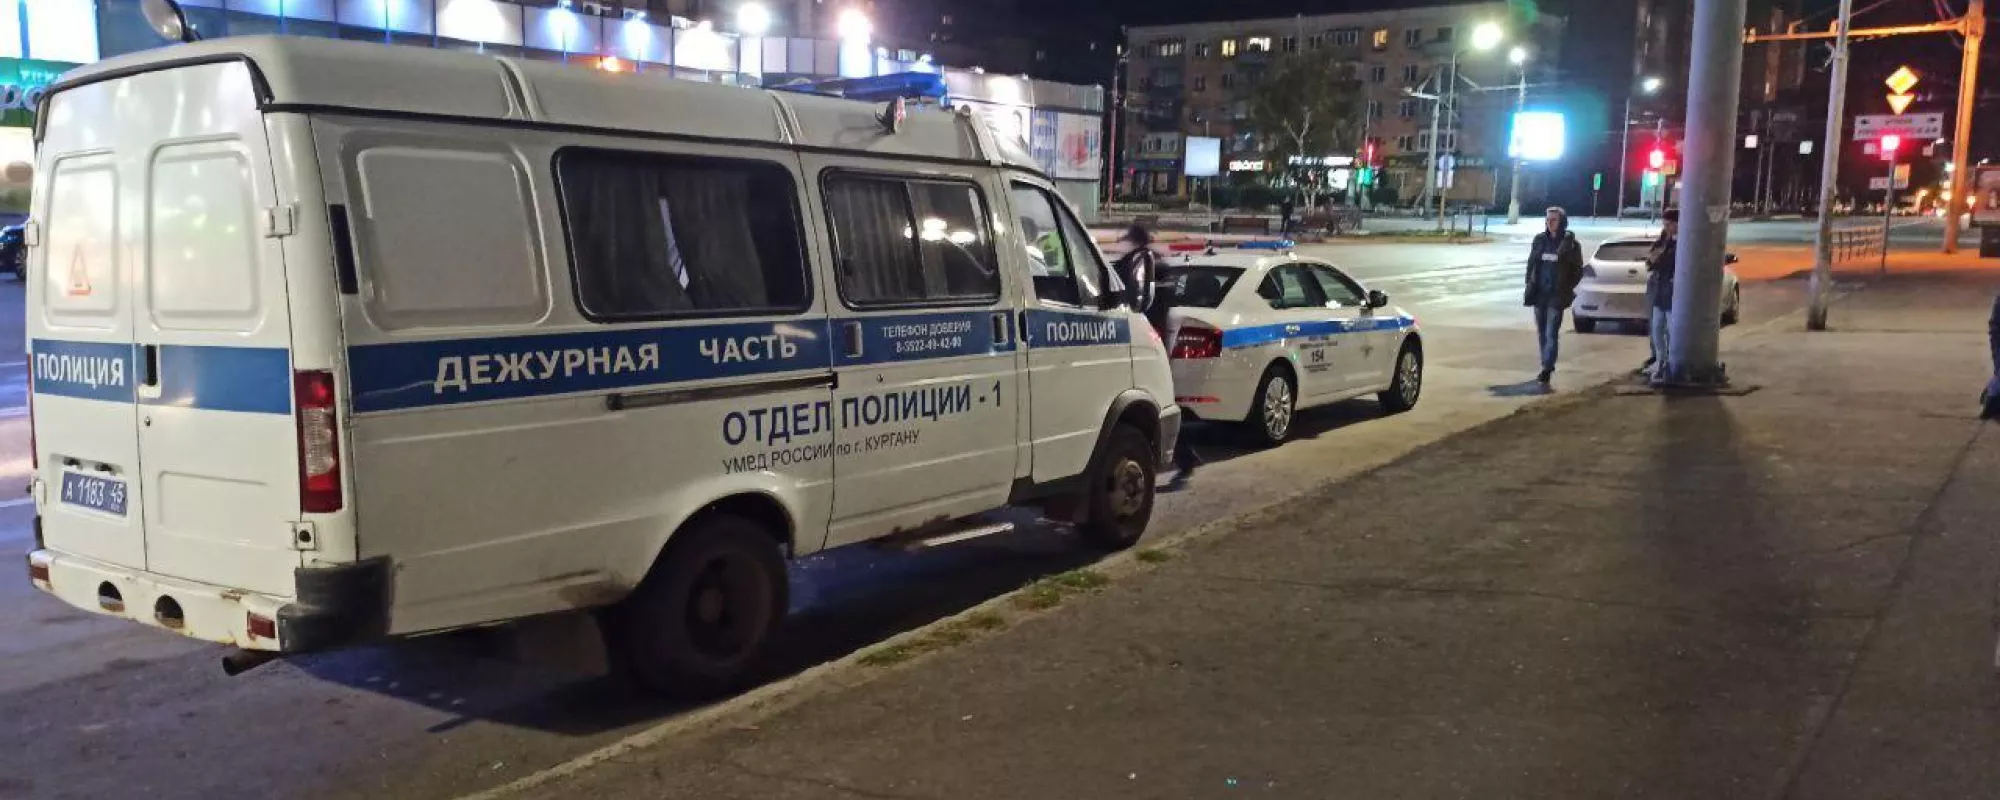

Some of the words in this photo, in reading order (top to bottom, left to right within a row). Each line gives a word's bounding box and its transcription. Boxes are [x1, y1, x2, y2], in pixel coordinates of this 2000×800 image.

[882, 325, 929, 338] ТЕЛЕФОН
[931, 320, 972, 335] ДОВЕРИЯ
[1046, 320, 1117, 341] ПОЛИЦИЯ
[36, 353, 124, 389] ПОЛИЦИЯ
[433, 342, 660, 394] ДЕЖУРНАЯ
[699, 333, 797, 364] ЧАСТЬ
[1311, 349, 1324, 362] 154
[722, 401, 832, 446] ОТДЕЛ
[841, 384, 971, 429] ПОЛИЦИИ
[993, 380, 1001, 407] 1
[771, 442, 834, 467] РОССИИ
[836, 442, 851, 457] по
[853, 440, 862, 453] г.
[864, 429, 921, 451] КУРГАНУ
[77, 477, 106, 507] 1183
